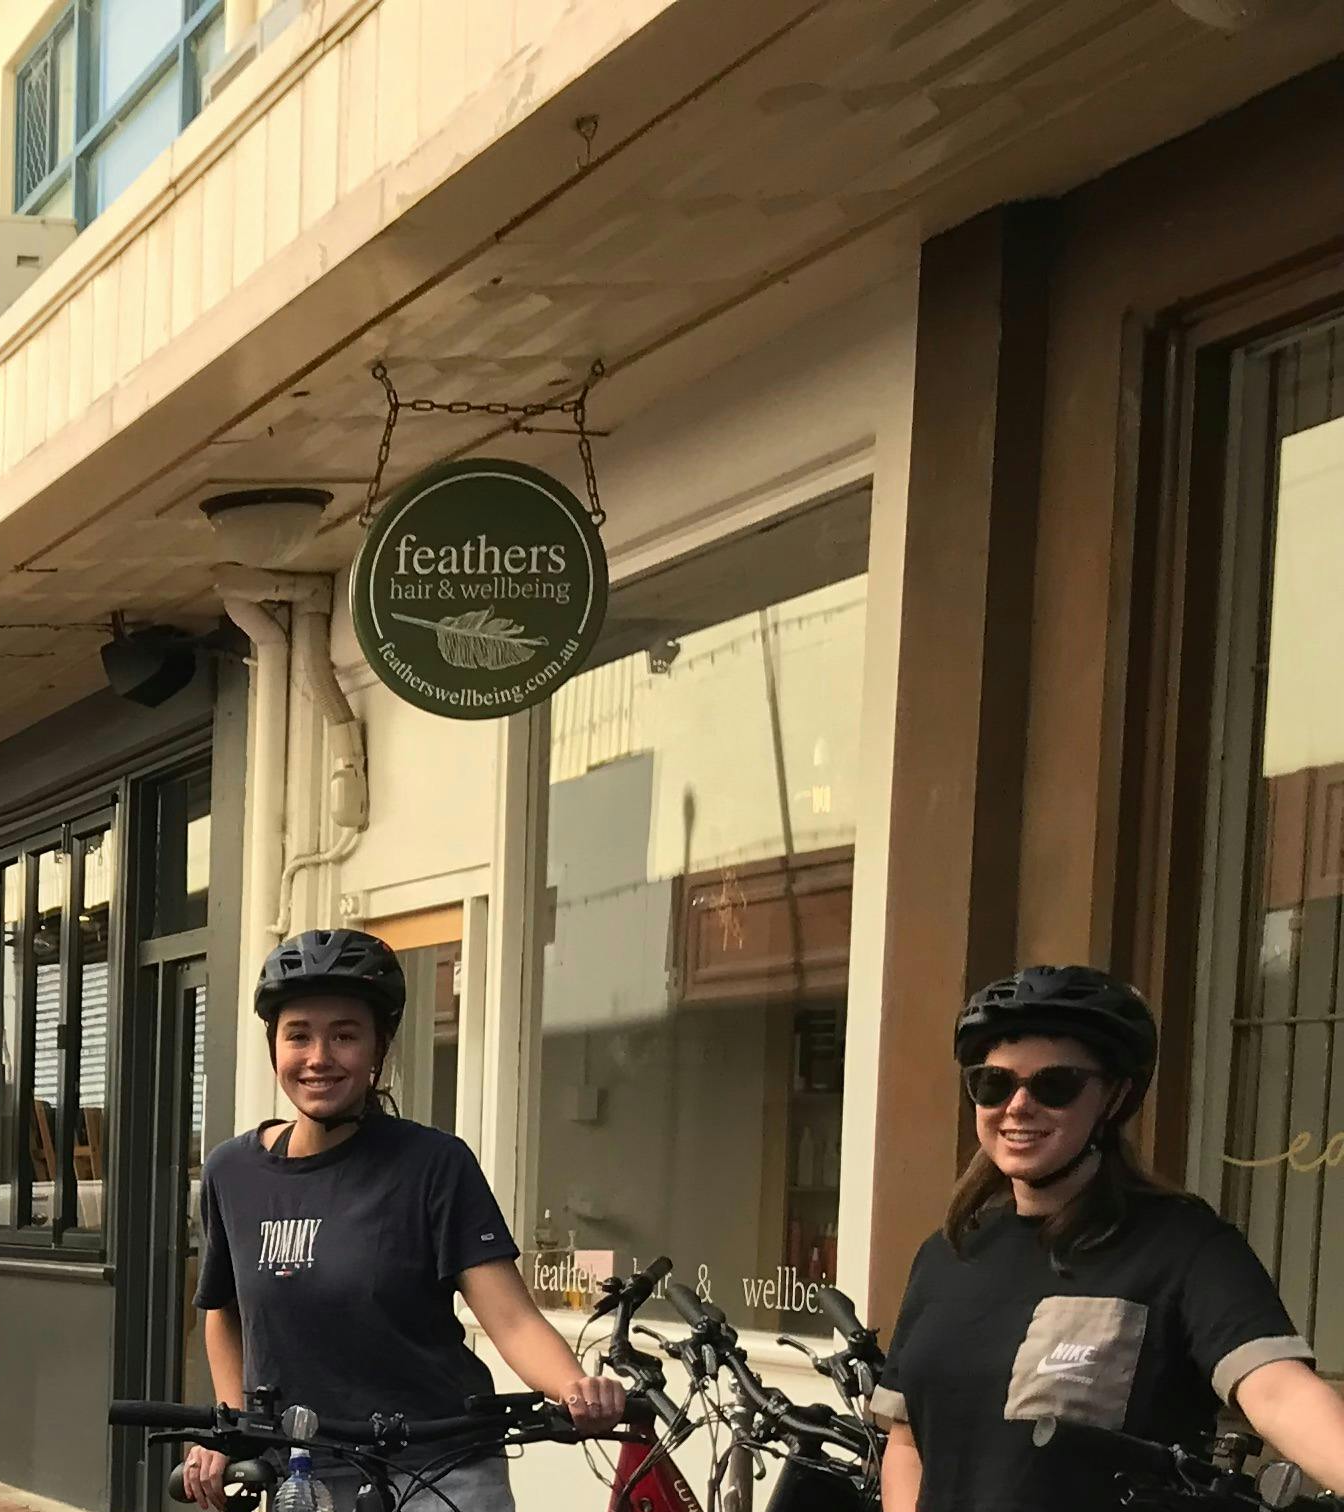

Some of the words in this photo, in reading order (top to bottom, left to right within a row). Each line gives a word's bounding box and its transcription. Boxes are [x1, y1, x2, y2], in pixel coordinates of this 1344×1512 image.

[394, 534, 567, 576] feathers
[390, 577, 434, 600] hair
[437, 578, 456, 600] &
[460, 577, 572, 605] wellbeing
[377, 638, 580, 707] featherswellbeing.com.au
[258, 1219, 322, 1263] TOMMY
[696, 1263, 714, 1303] &
[1050, 1342, 1099, 1362] NIKE
